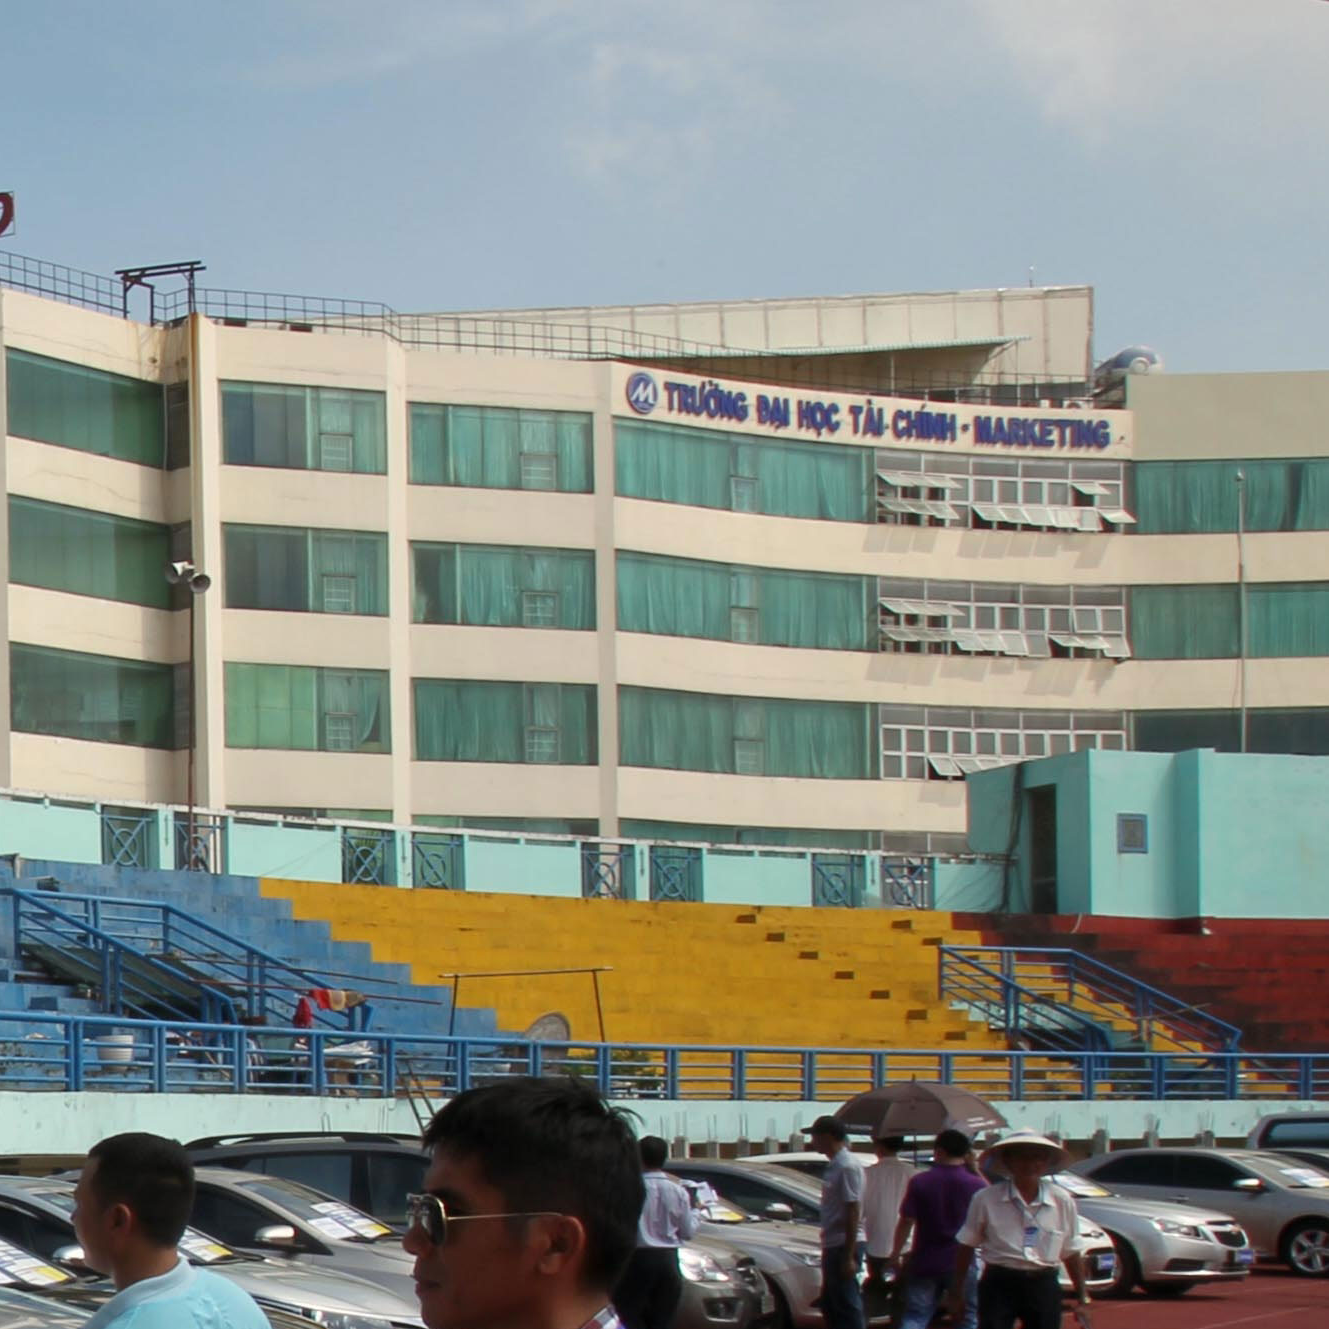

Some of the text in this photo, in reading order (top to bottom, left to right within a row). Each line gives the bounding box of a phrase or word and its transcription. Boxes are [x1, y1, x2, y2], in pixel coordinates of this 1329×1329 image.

[664, 380, 749, 423] TRƯỜNG
[797, 399, 841, 436] HỌC
[892, 403, 956, 442] CHÍNH
[973, 415, 1110, 449] MARKETING
